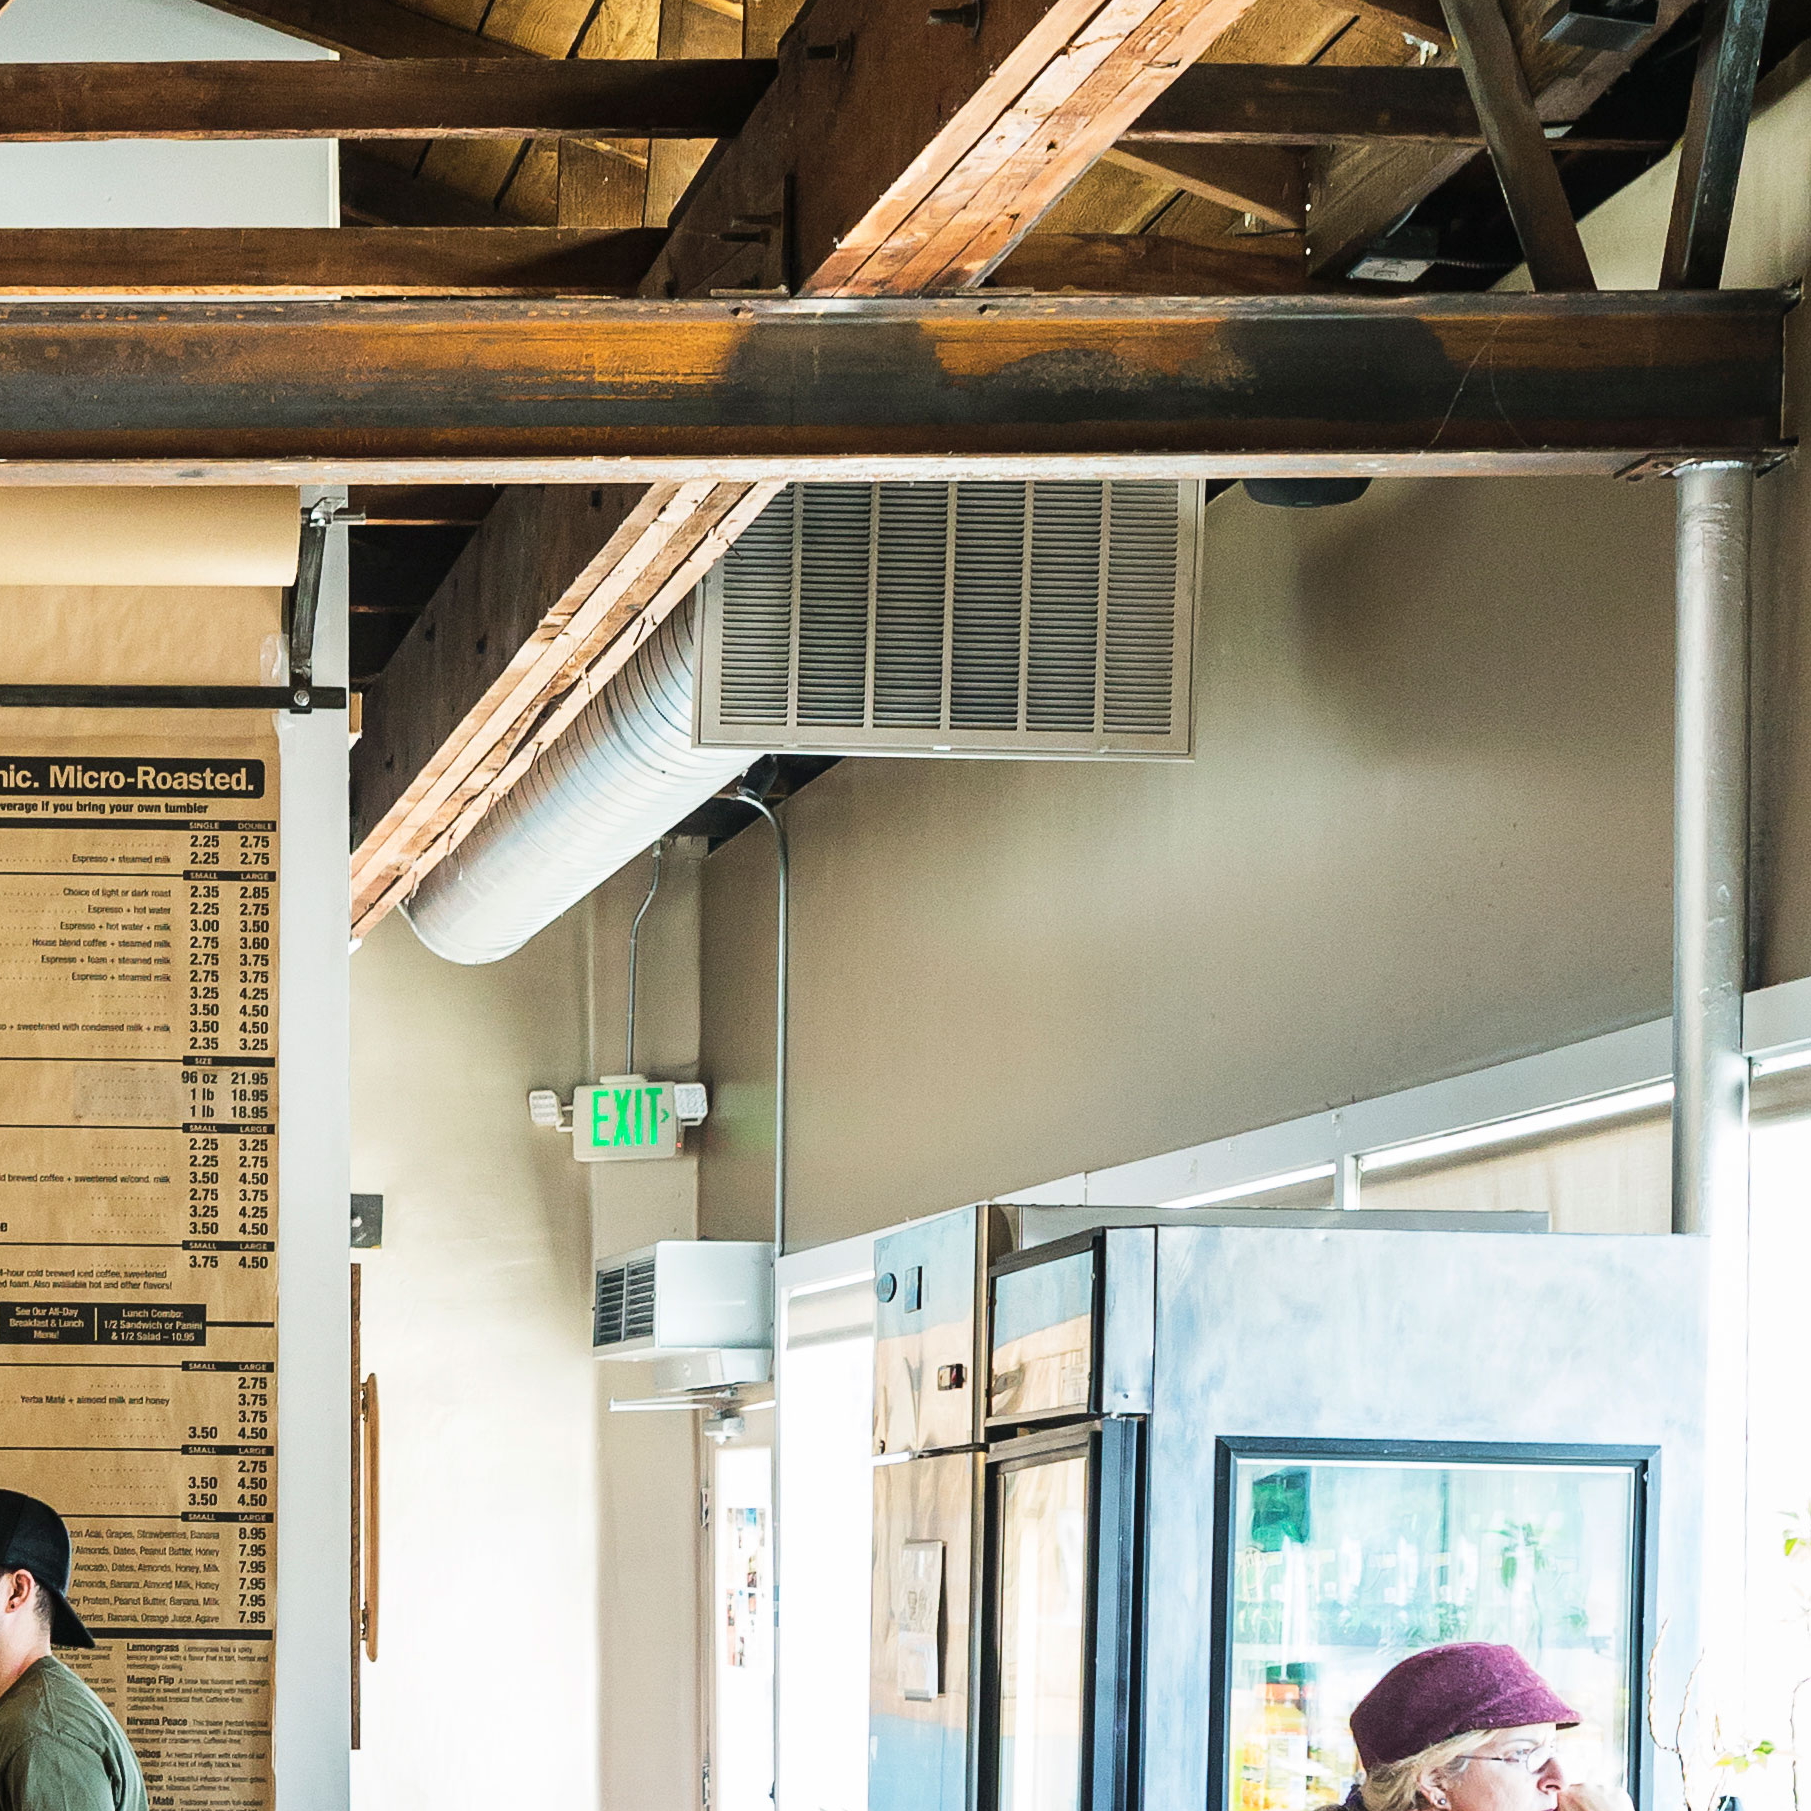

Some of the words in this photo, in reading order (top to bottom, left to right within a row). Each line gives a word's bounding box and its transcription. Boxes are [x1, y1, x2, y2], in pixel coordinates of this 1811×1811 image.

[49, 765, 254, 791] Micro-Roasted.
[41, 800, 50, 812] if
[52, 803, 73, 814] you
[76, 800, 106, 815] bring
[109, 803, 135, 815] your
[137, 803, 162, 813] own
[164, 802, 209, 814] tumbler
[189, 834, 220, 849] 2.25
[239, 835, 270, 849] 2.75
[190, 885, 220, 899] 2.35
[239, 886, 270, 900] 2.85
[181, 1070, 198, 1084] 96
[201, 1073, 218, 1085] oz
[230, 1071, 269, 1086] 21.95
[592, 1087, 663, 1147] EXIT
[189, 1254, 219, 1269] 3.75
[238, 1255, 269, 1269] 4.50
[238, 1527, 267, 1541] 8.95
[126, 1642, 180, 1654] Lemongrass
